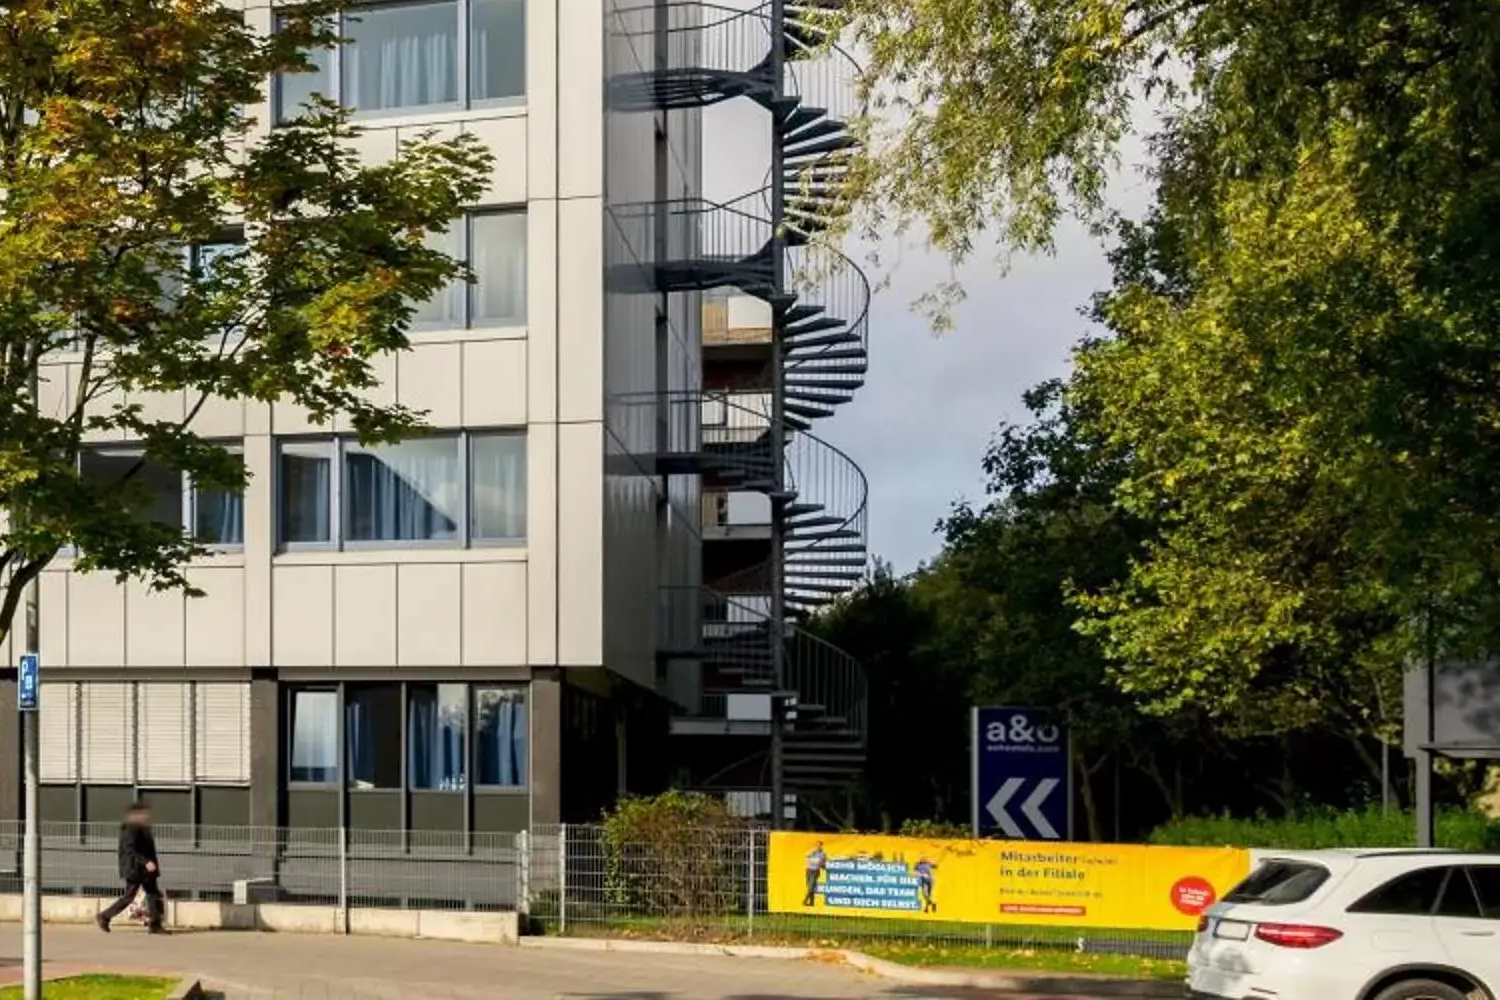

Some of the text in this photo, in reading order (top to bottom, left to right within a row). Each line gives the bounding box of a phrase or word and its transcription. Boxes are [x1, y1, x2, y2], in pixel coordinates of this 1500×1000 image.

[986, 714, 1060, 743] a&o
[1000, 851, 1078, 864] Mitarbeiter
[1000, 867, 1085, 880] in der Filiale
